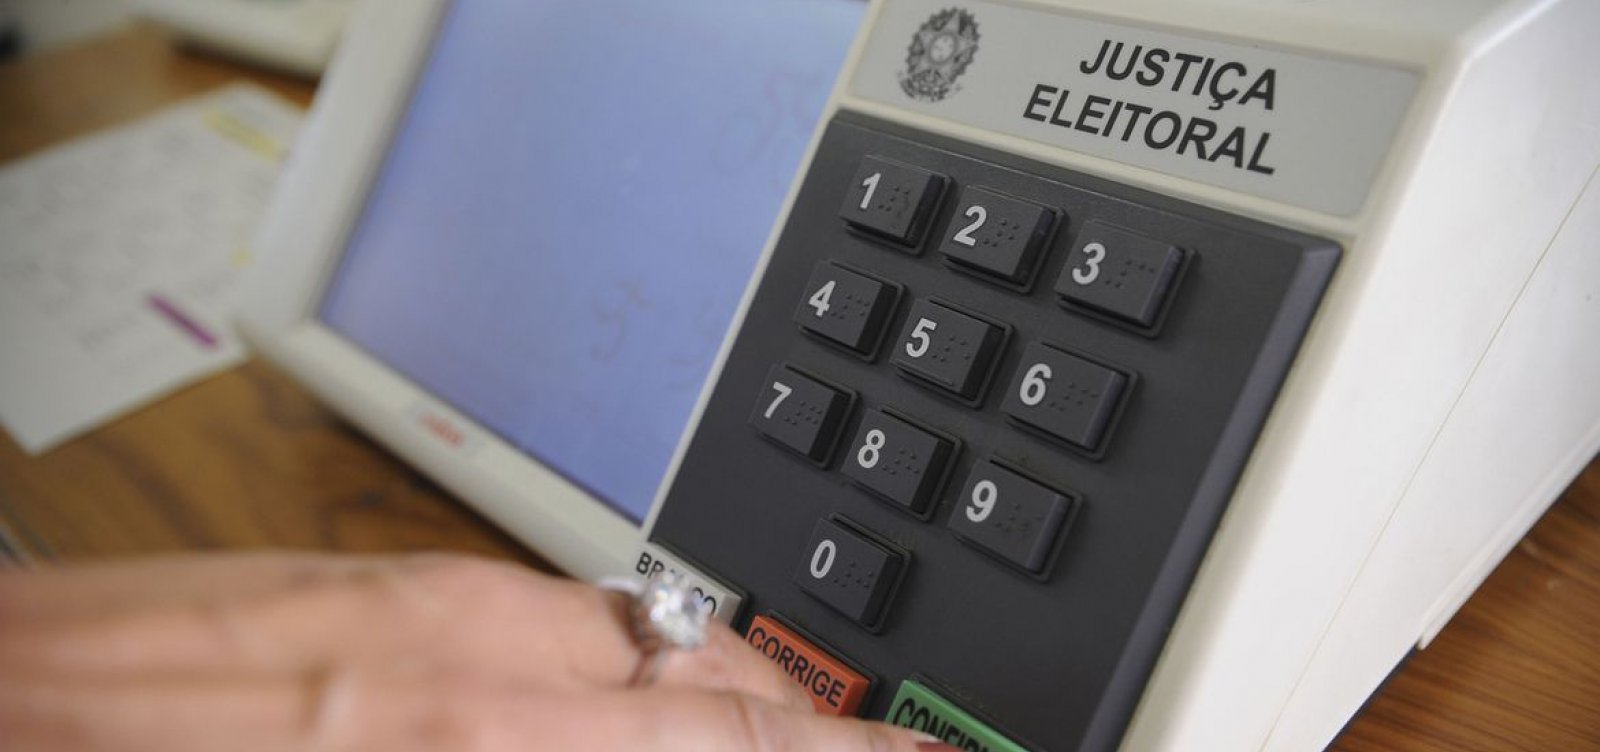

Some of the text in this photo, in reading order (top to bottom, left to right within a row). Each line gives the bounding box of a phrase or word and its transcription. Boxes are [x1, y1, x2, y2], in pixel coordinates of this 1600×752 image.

[1079, 39, 1277, 111] JUSTIÇA
[1022, 83, 1276, 175] ELEITORAL
[860, 172, 882, 210] 1
[953, 205, 987, 247] 2
[1072, 242, 1106, 285] 3
[808, 280, 836, 317] 4
[905, 317, 937, 358] 5
[764, 381, 793, 419] 7
[1019, 363, 1052, 406] 6
[857, 429, 886, 469] 8
[966, 479, 998, 523] 9
[810, 539, 837, 579] 0
[749, 627, 846, 707] CORRIGE
